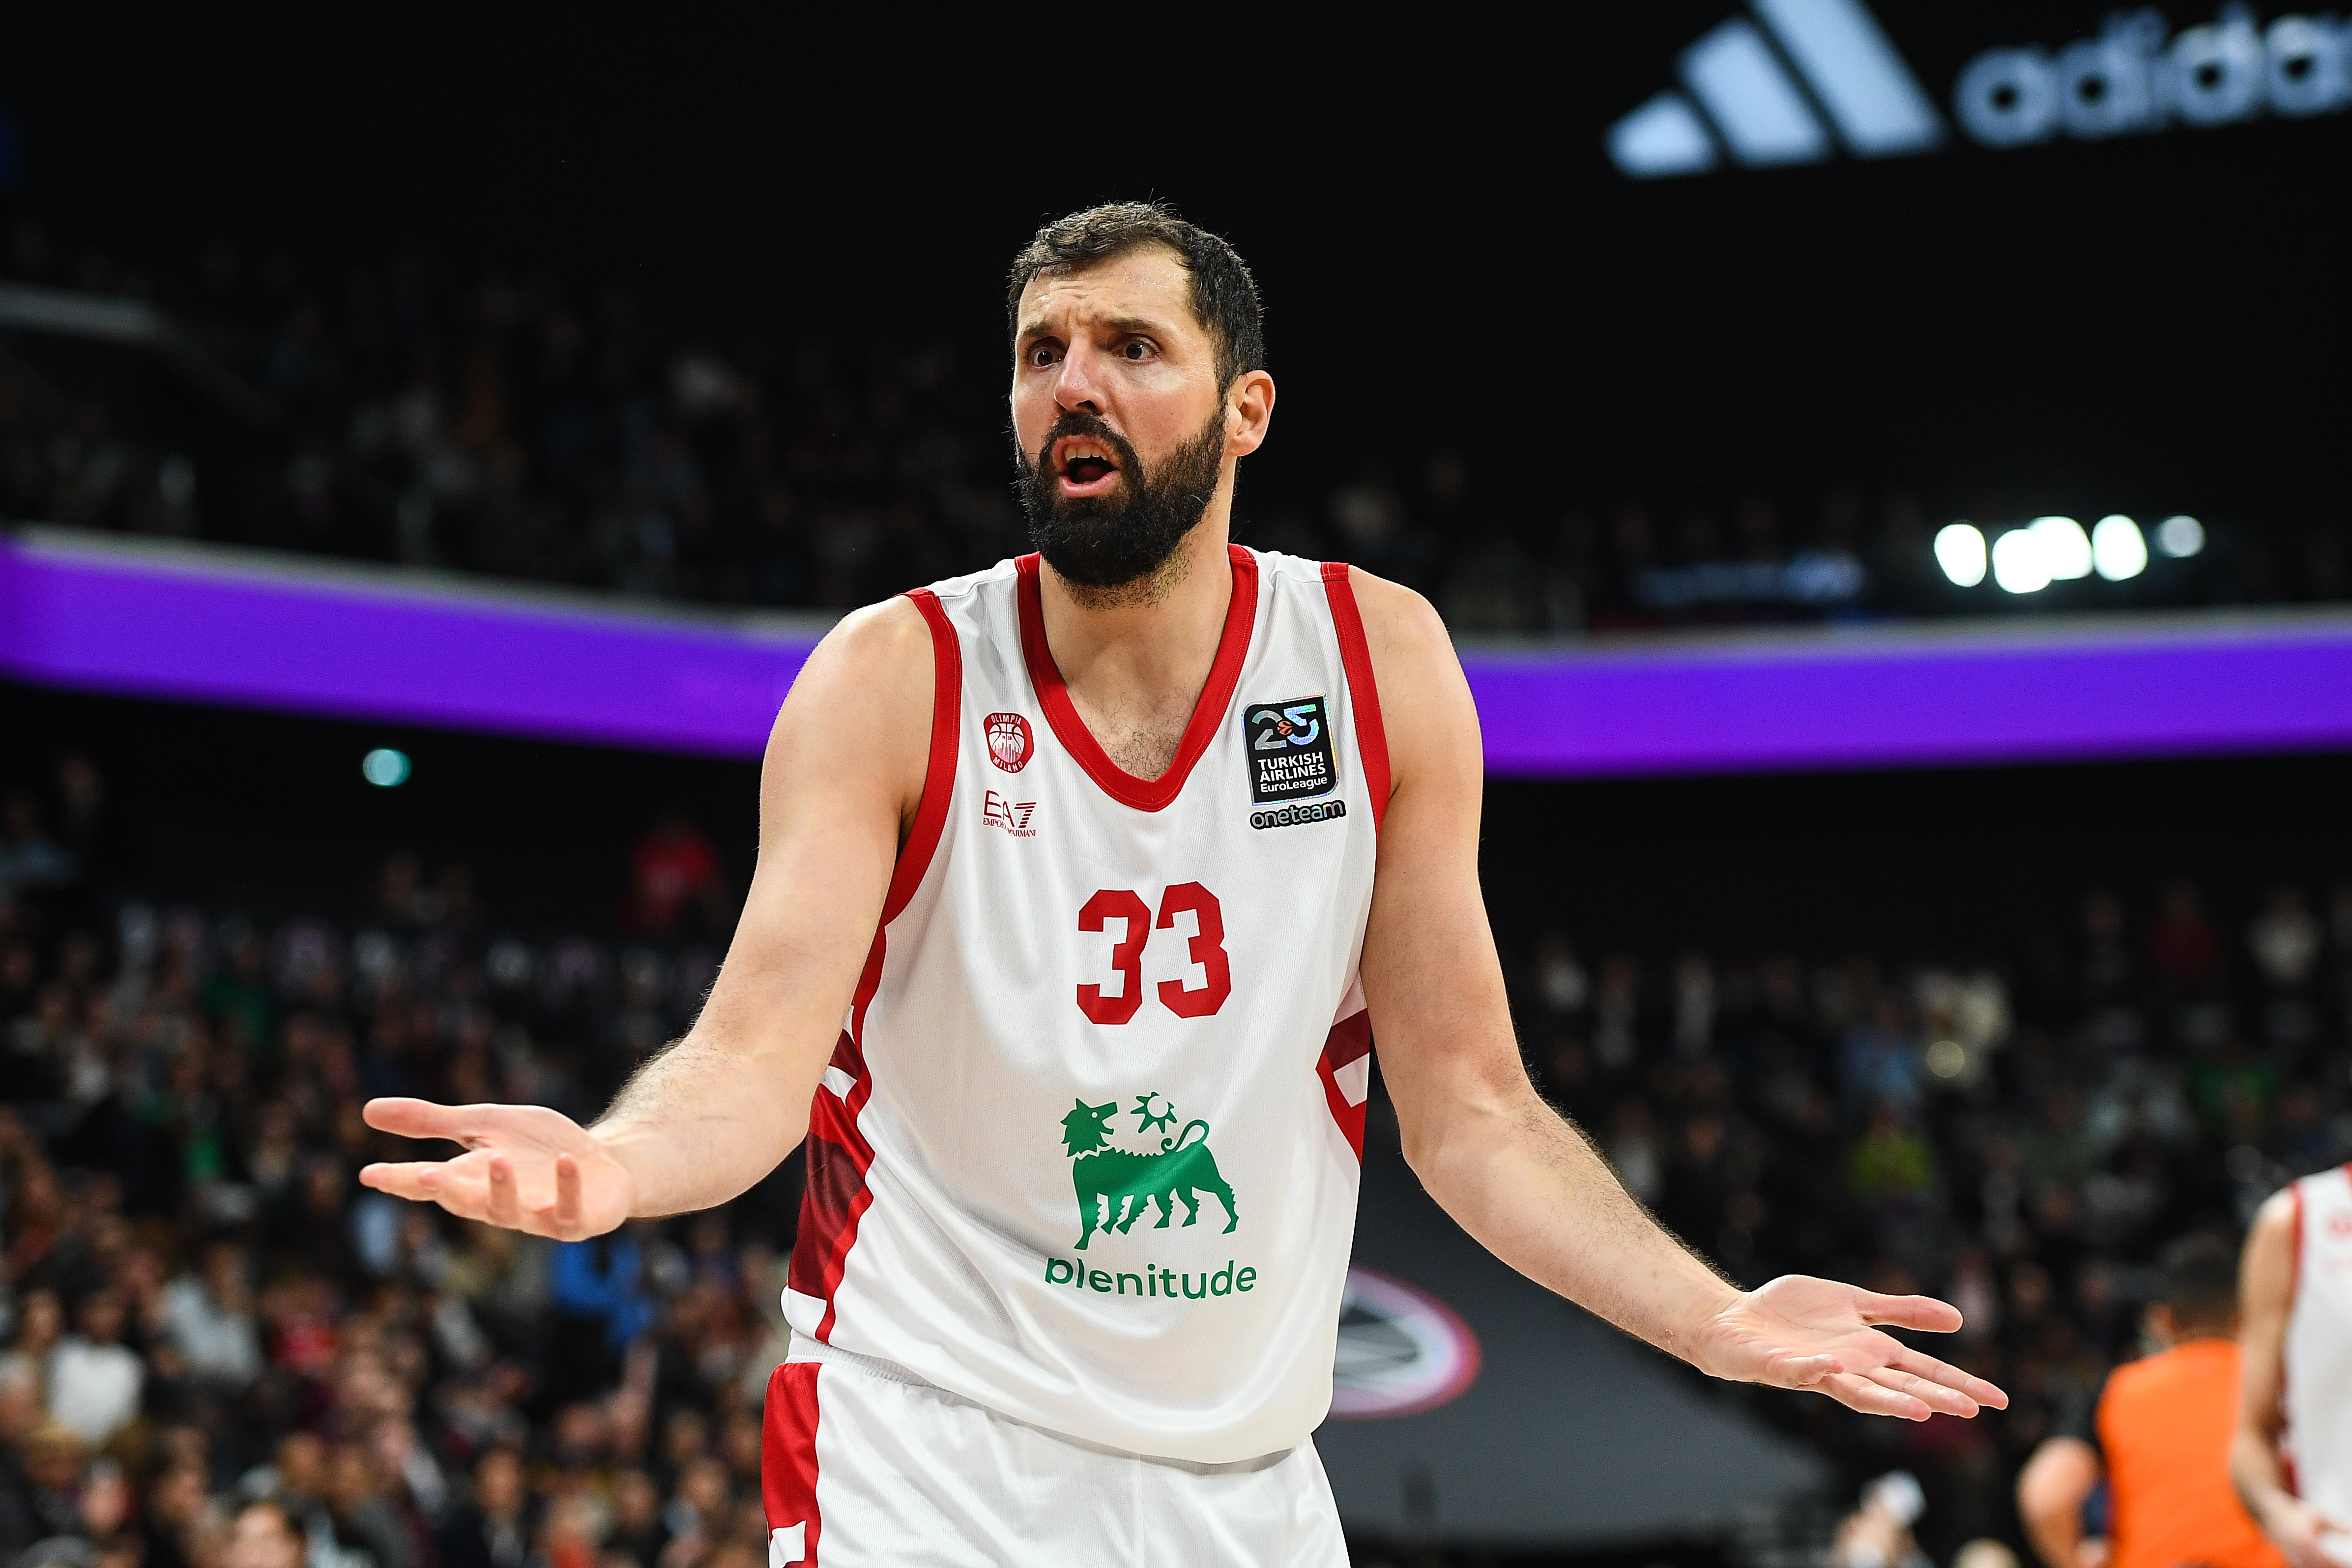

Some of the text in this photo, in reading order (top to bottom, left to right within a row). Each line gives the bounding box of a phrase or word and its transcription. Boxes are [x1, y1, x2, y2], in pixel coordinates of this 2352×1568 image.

[1955, 2, 2352, 147] adida
[991, 714, 1022, 726] OLIMPIA
[1251, 704, 1319, 751] 25
[993, 756, 1023, 772] MILANO
[1257, 752, 1324, 770] TURKISH
[1260, 763, 1326, 783] AIRLINES
[1260, 776, 1328, 793] EuroLeague
[984, 790, 1037, 828] EA7
[1251, 801, 1343, 827] oneteam
[1076, 881, 1231, 1024] 33
[1045, 1257, 1256, 1300] plenitude
